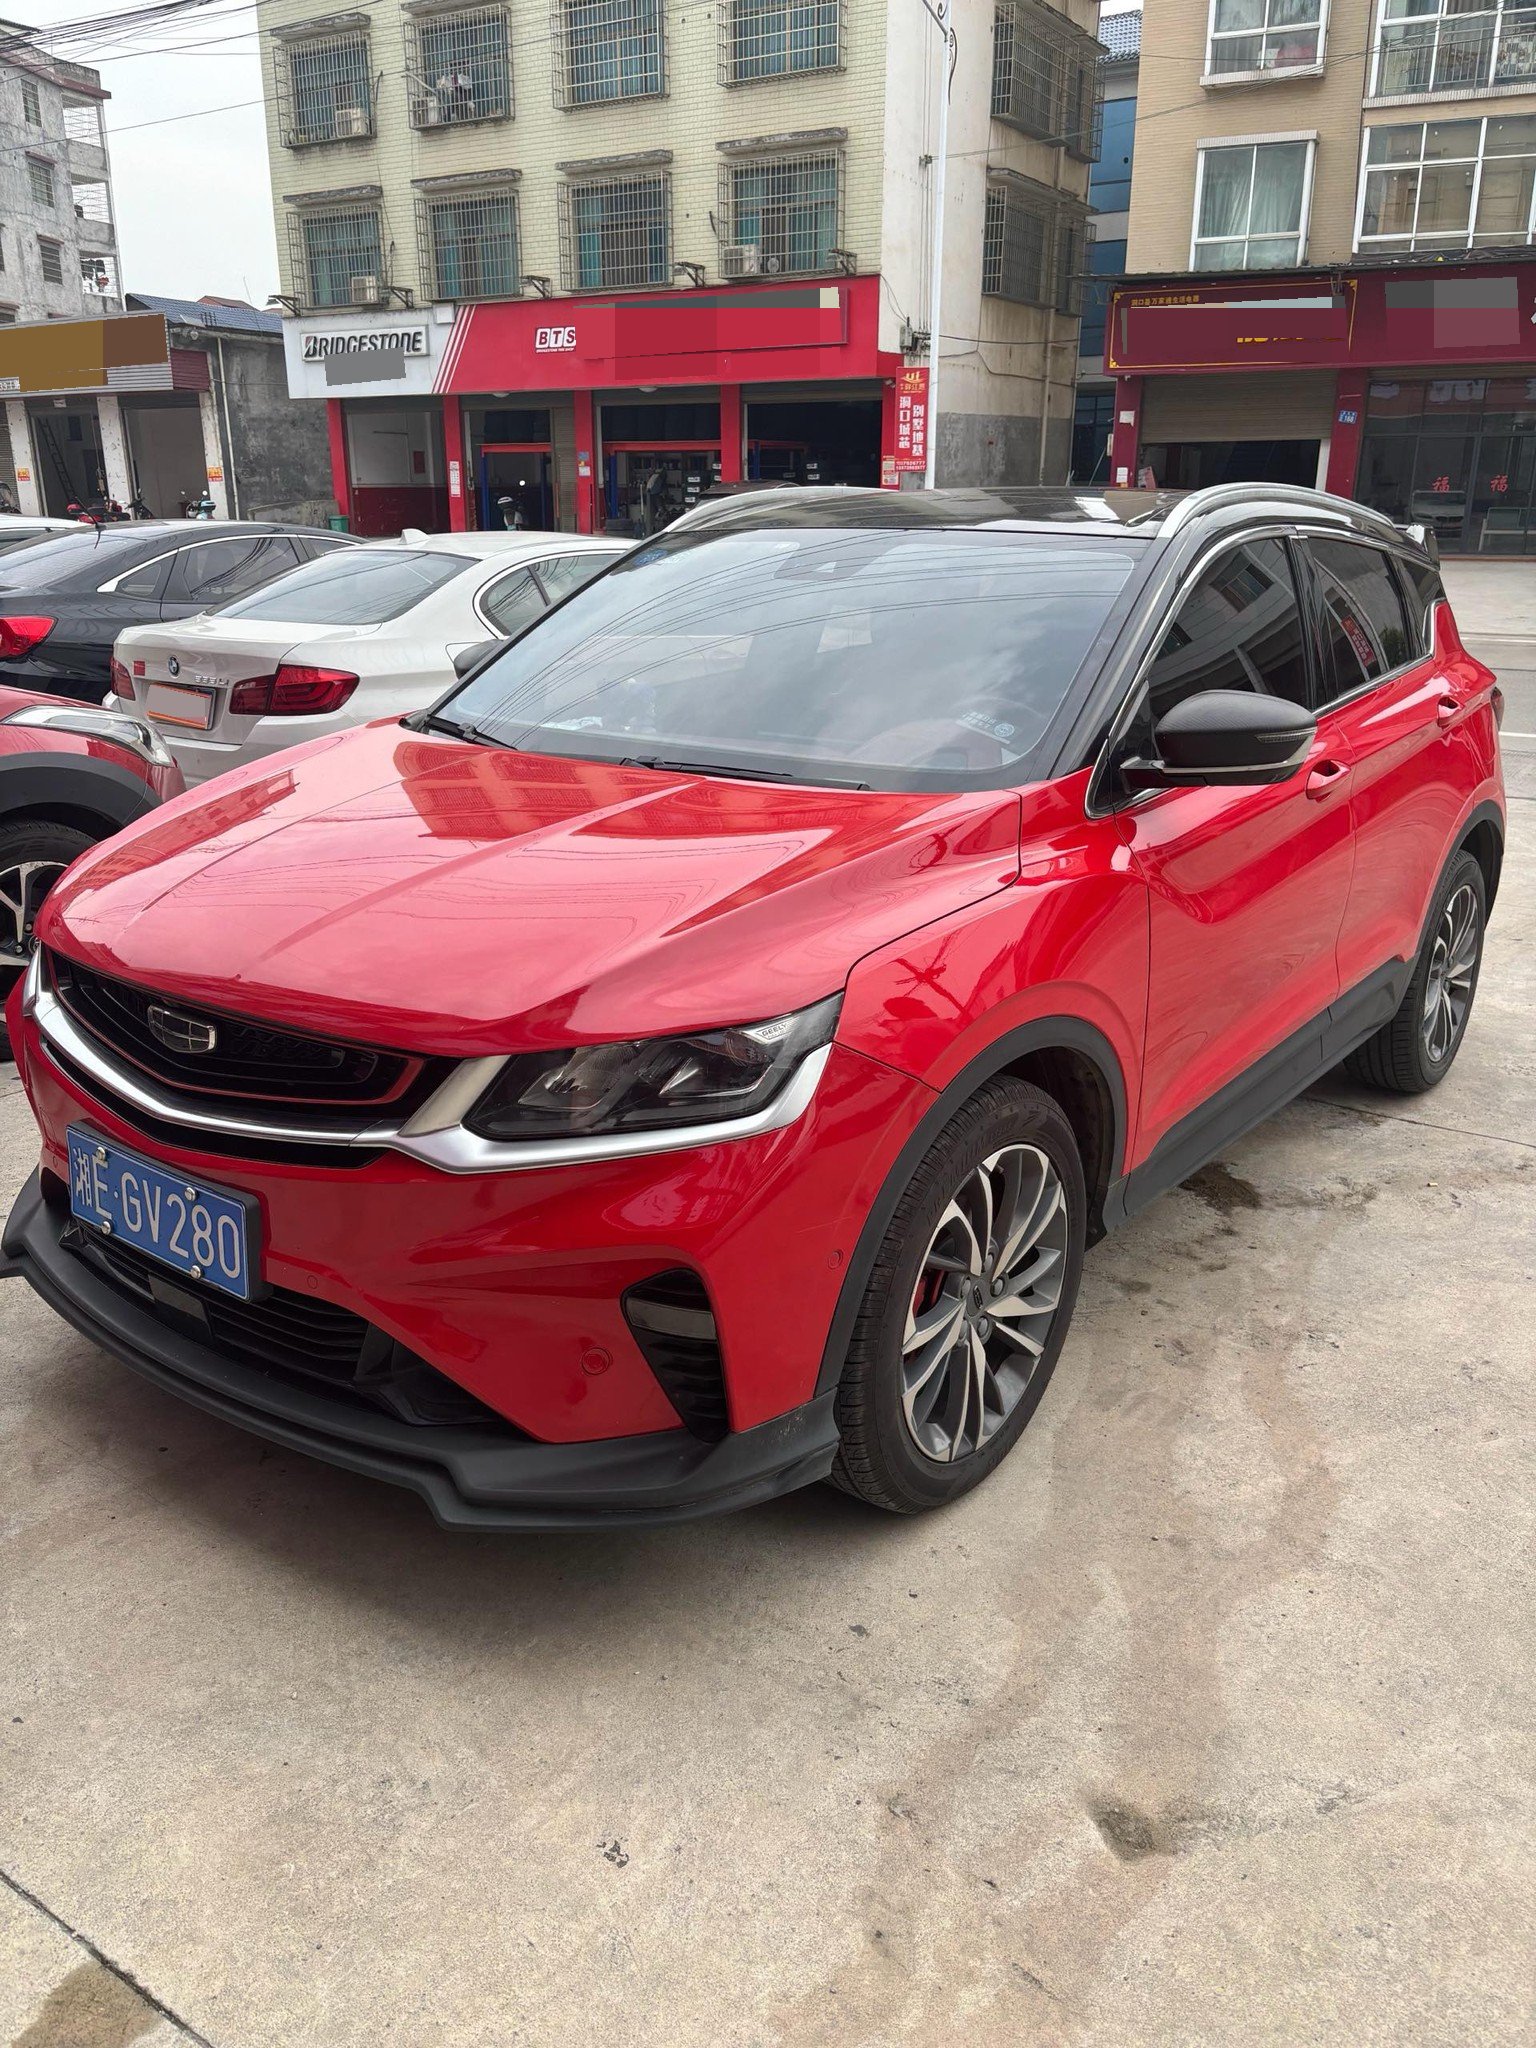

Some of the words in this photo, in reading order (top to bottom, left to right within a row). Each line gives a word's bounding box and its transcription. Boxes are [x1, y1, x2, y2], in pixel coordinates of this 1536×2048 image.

[538, 328, 576, 347] BTS
[1432, 476, 1450, 493] 福
[1490, 474, 1509, 492] 福
[761, 1023, 788, 1037] GEELY
[72, 1146, 242, 1280] 湘E·GV280
